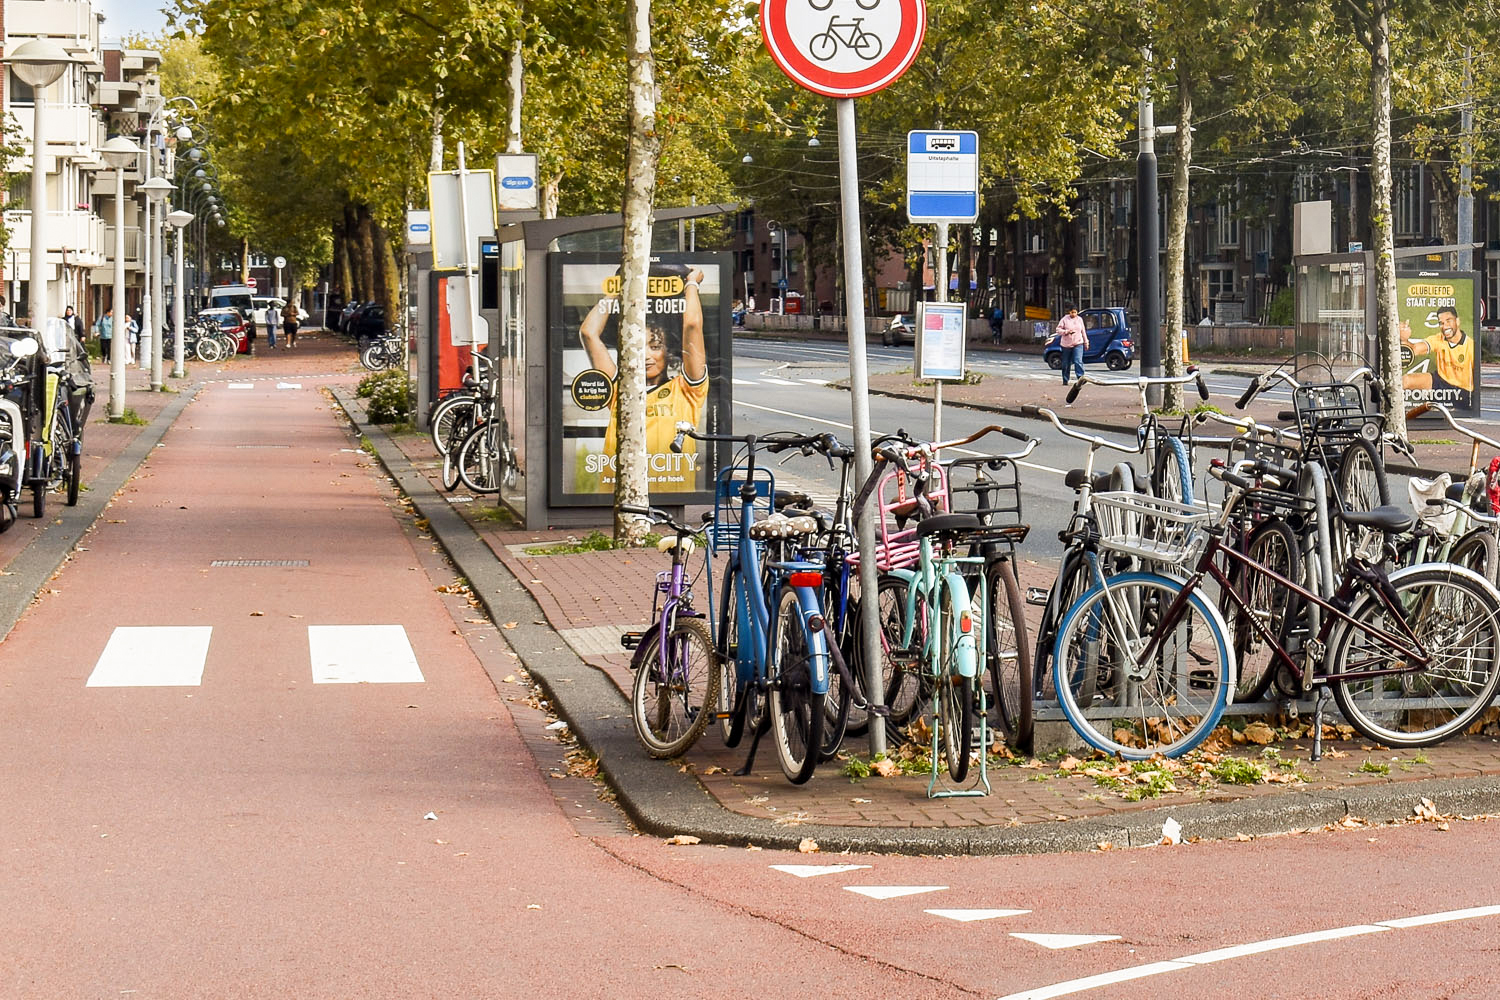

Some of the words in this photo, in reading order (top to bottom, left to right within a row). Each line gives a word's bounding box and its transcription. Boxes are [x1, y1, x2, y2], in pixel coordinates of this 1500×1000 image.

[607, 278, 679, 294] CLEFDE
[1410, 286, 1451, 295] CLUBLIEFDE
[600, 298, 620, 314] STA
[644, 298, 652, 314] E
[655, 298, 687, 314] GOED
[1406, 298, 1427, 307] STAAT
[1428, 298, 1437, 307] JE
[1437, 298, 1456, 307] GOED
[1403, 388, 1463, 401] PORTCITY.
[585, 453, 701, 473] SPTCITY.
